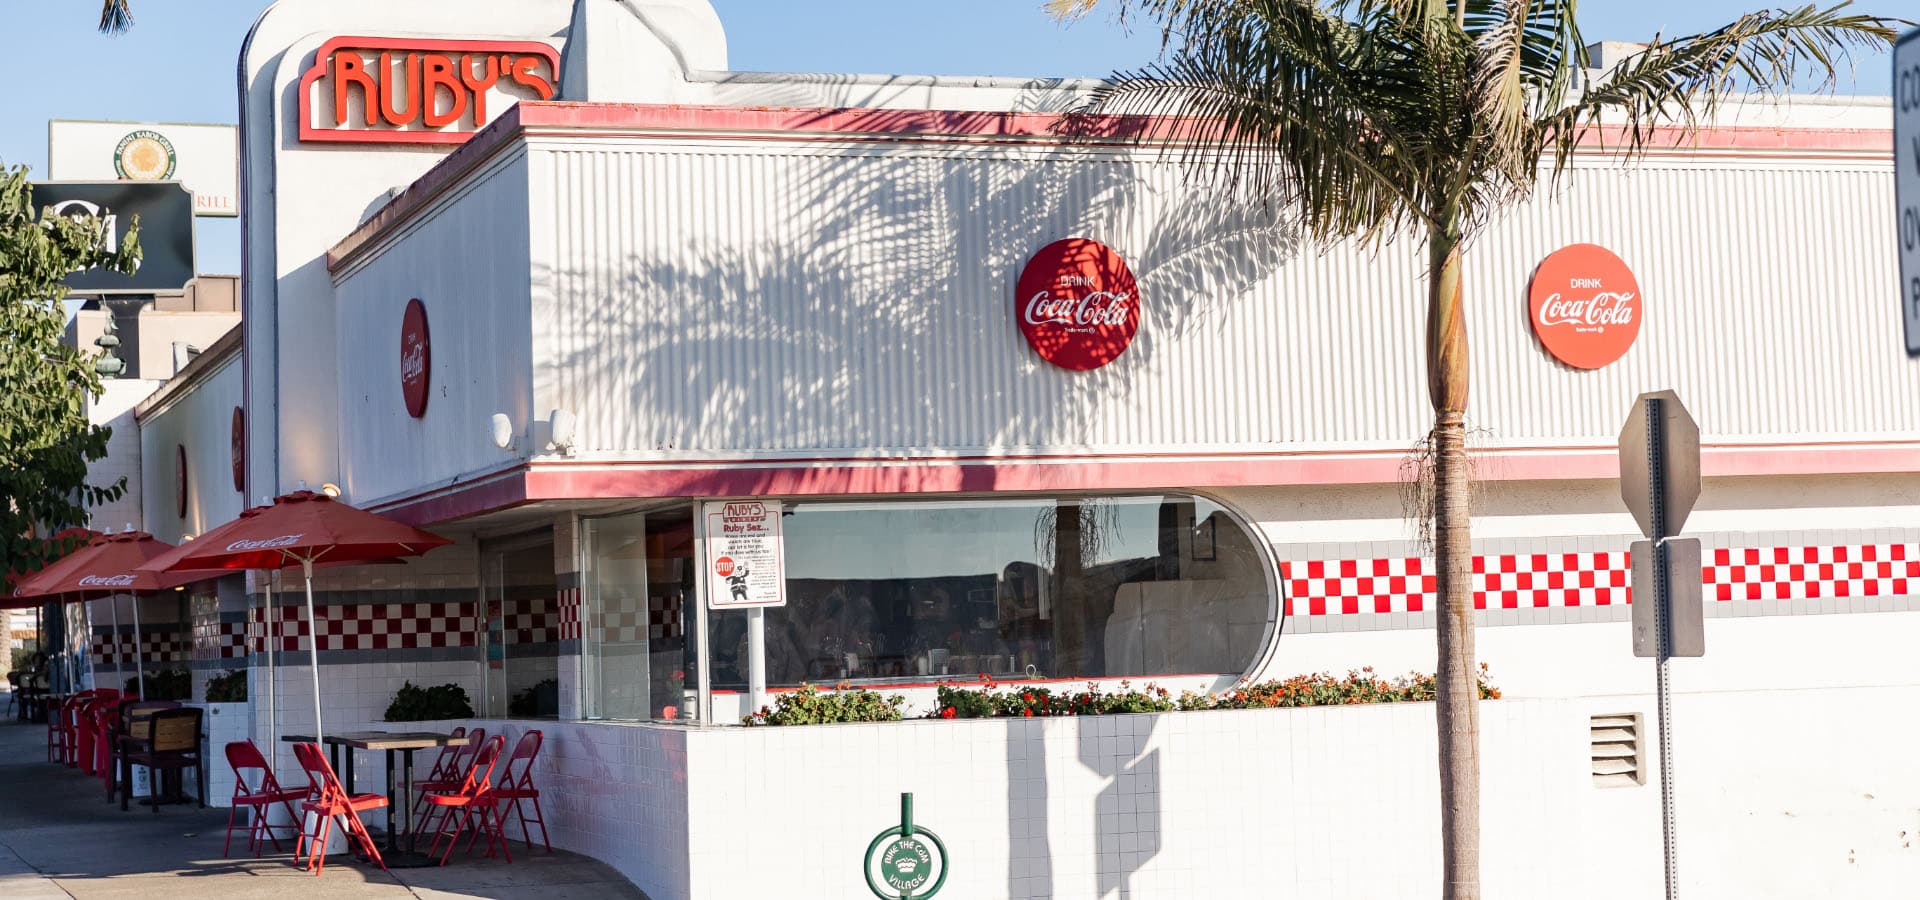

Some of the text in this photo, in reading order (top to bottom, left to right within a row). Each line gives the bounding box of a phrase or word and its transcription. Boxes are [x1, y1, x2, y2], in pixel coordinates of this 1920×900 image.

[335, 52, 554, 127] RUBY'S
[197, 195, 230, 208] RILL
[1060, 275, 1095, 286] DRINK
[1570, 278, 1602, 289] DRINK
[1025, 290, 1132, 325] Coca-Cola
[1539, 291, 1636, 326] Coca-Cola
[724, 524, 744, 534] Ruby
[226, 534, 303, 551] Coca-Cola
[716, 562, 734, 573] STOP
[79, 575, 137, 586] Coca-Cola
[899, 841, 914, 850] THE
[888, 874, 925, 890] VILLAGE
